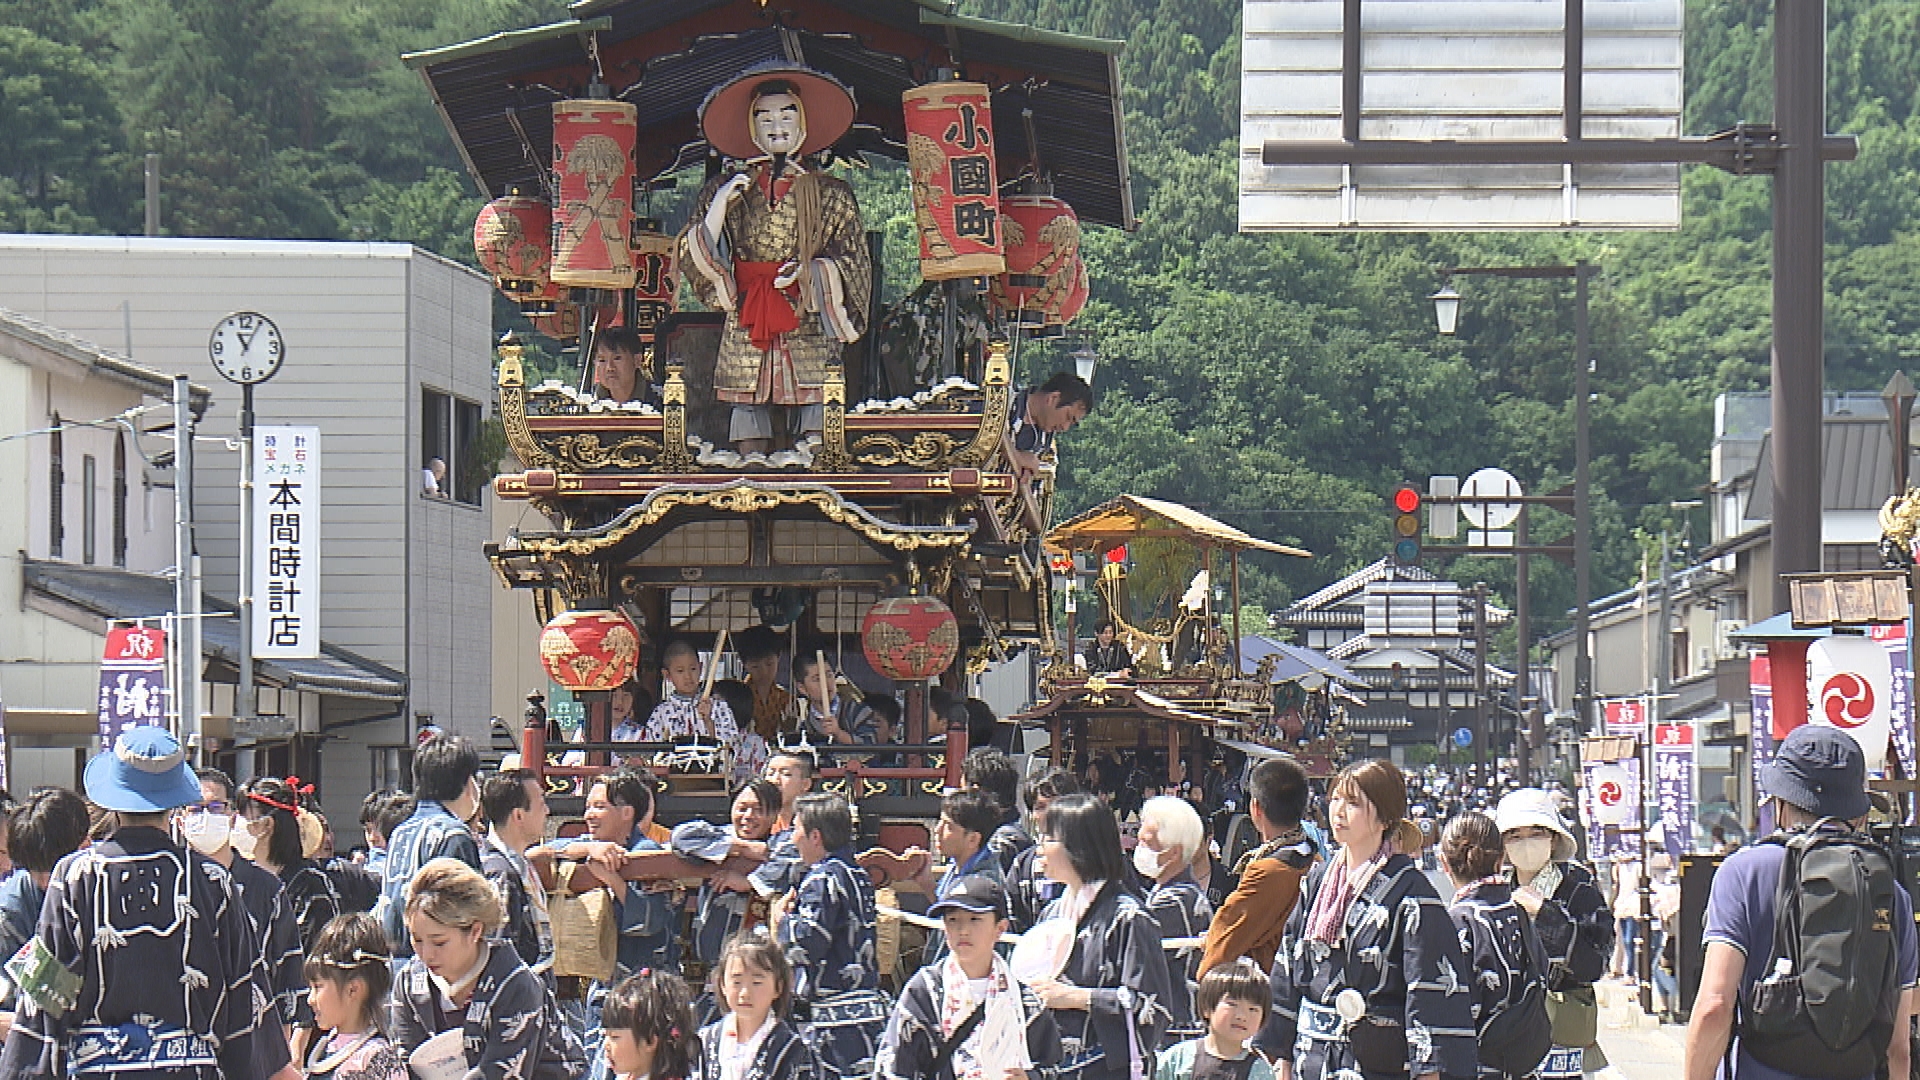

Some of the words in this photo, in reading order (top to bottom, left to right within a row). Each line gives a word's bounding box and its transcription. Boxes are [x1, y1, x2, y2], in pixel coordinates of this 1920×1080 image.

[942, 102, 999, 248] 小國町
[636, 253, 675, 336] 小國
[240, 315, 253, 329] 12
[213, 341, 224, 355] 9
[268, 341, 279, 355] 3
[242, 366, 253, 381] 6
[264, 448, 307, 461] 宝石
[268, 478, 302, 647] 本間時計店
